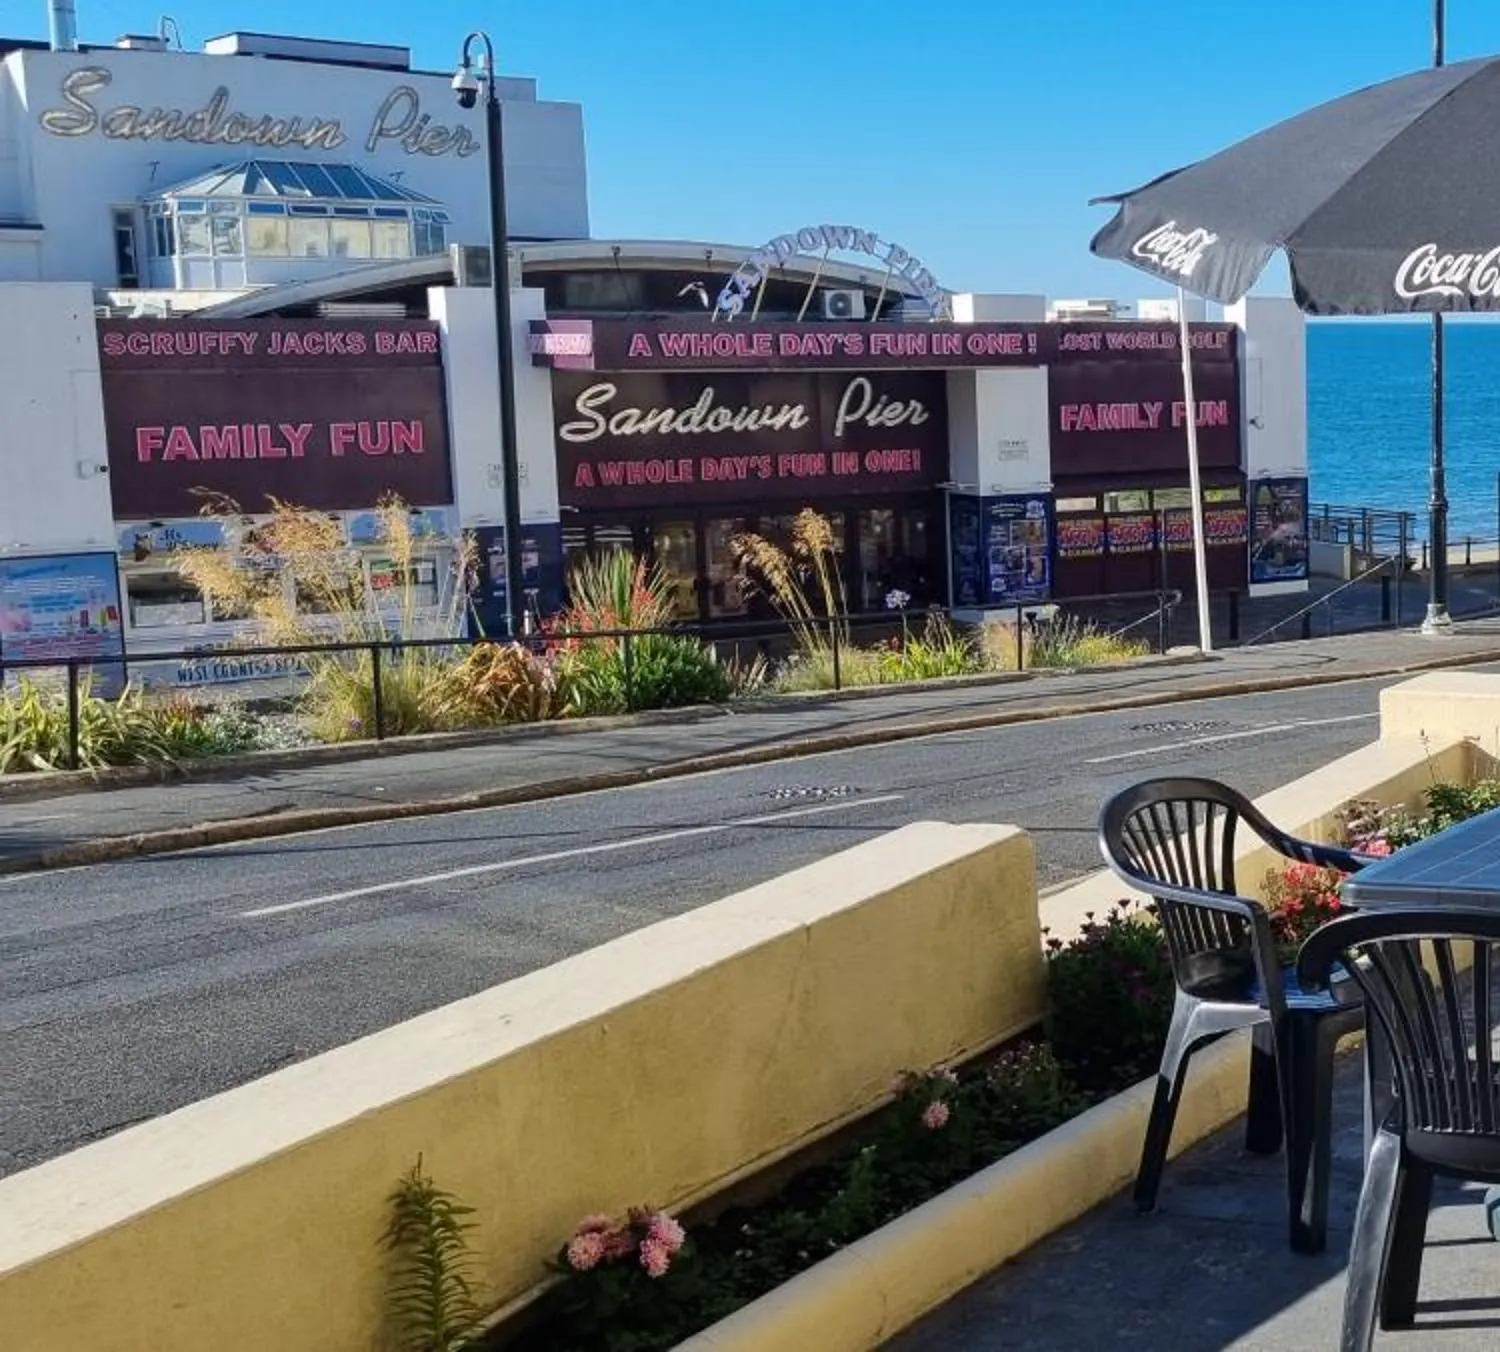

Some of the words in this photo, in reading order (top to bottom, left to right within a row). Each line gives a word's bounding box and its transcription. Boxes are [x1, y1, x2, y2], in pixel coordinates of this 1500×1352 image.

[40, 66, 346, 150] Sandown
[366, 85, 480, 158] Pier
[1132, 220, 1219, 275] Coca-Cola
[103, 331, 258, 356] SCRUFFY
[267, 331, 366, 355] JACKS
[376, 331, 437, 353] BAR
[628, 334, 652, 357] A
[659, 333, 773, 356] WHOLE
[780, 333, 864, 356] DAY'S
[869, 333, 927, 355] FUN
[931, 333, 962, 354] IN
[1106, 331, 1176, 349] WORLD
[1179, 331, 1227, 348] OLF
[559, 383, 810, 442] Sandown
[834, 377, 928, 437] Pier
[1060, 402, 1162, 431] FAMILY
[1172, 401, 1228, 427] FUN
[136, 422, 313, 462] FAMILY
[330, 420, 424, 456] FUN
[575, 463, 593, 487] A
[598, 458, 693, 486] WHOLE
[701, 455, 771, 483] DAY'S
[778, 452, 825, 477] FUN
[833, 450, 859, 475] IN
[866, 449, 921, 473] ONE!
